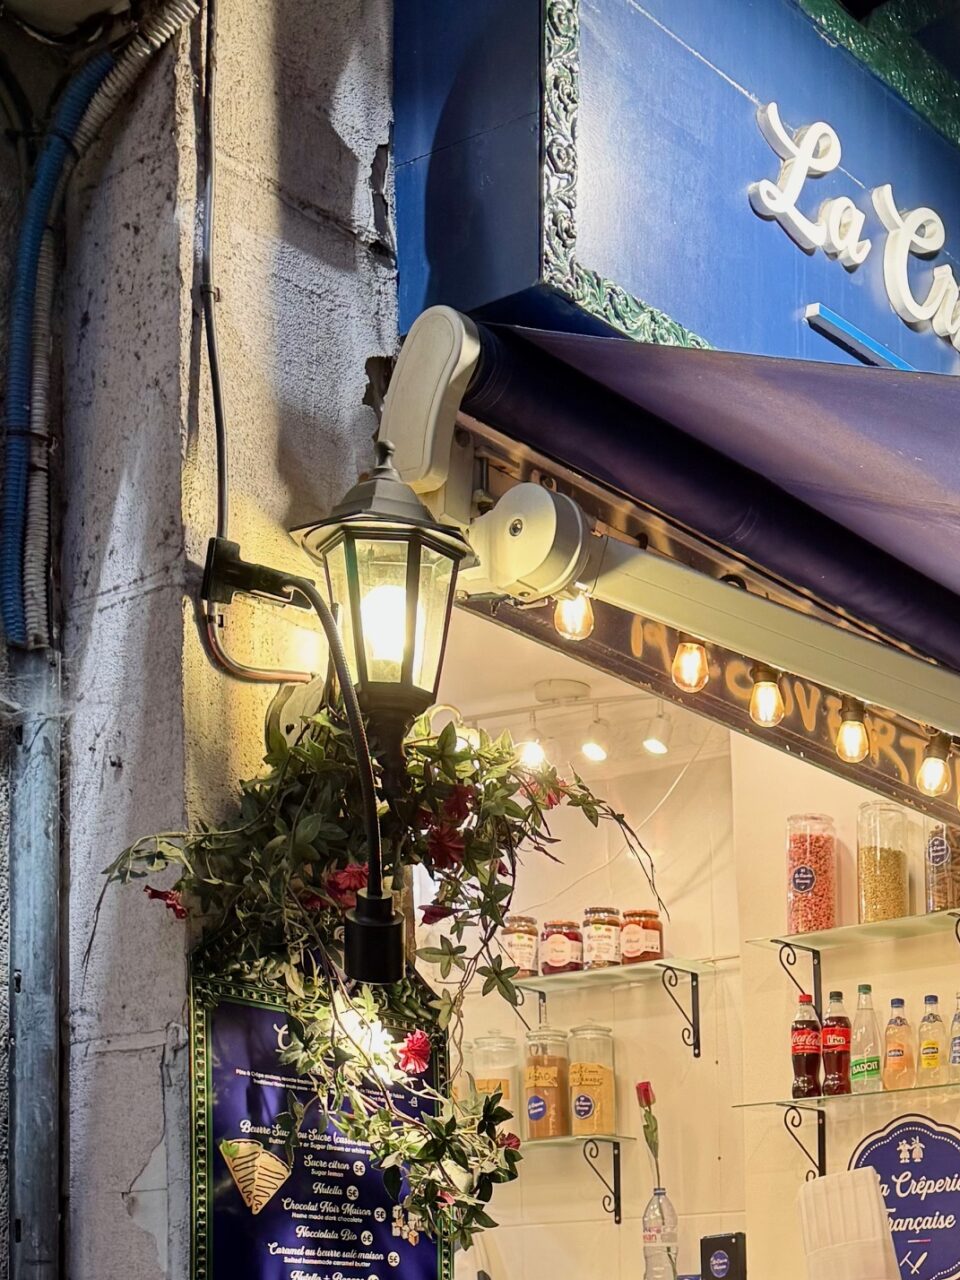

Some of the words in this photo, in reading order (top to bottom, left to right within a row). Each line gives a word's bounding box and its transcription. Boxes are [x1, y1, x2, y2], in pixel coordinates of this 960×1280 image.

[749, 102, 871, 269] La
[304, 1155, 327, 1169] Sucre
[328, 1159, 349, 1171] citron
[311, 1169, 329, 1178] Sugar
[312, 1182, 342, 1196] Nutella
[282, 1197, 318, 1212] Chocolat
[320, 1201, 340, 1213] Noir
[341, 1203, 371, 1216] Maison
[307, 1213, 322, 1221] made
[323, 1214, 336, 1222] dark
[337, 1215, 362, 1224] chocolate
[886, 1208, 956, 1234] rançaise
[296, 1226, 339, 1240] Nocciolata
[341, 1227, 357, 1241] Bio
[268, 1242, 304, 1257] Caramel
[305, 1248, 315, 1256] au
[316, 1246, 341, 1258] beurre
[342, 1247, 357, 1259] salé
[358, 1251, 384, 1260] maison
